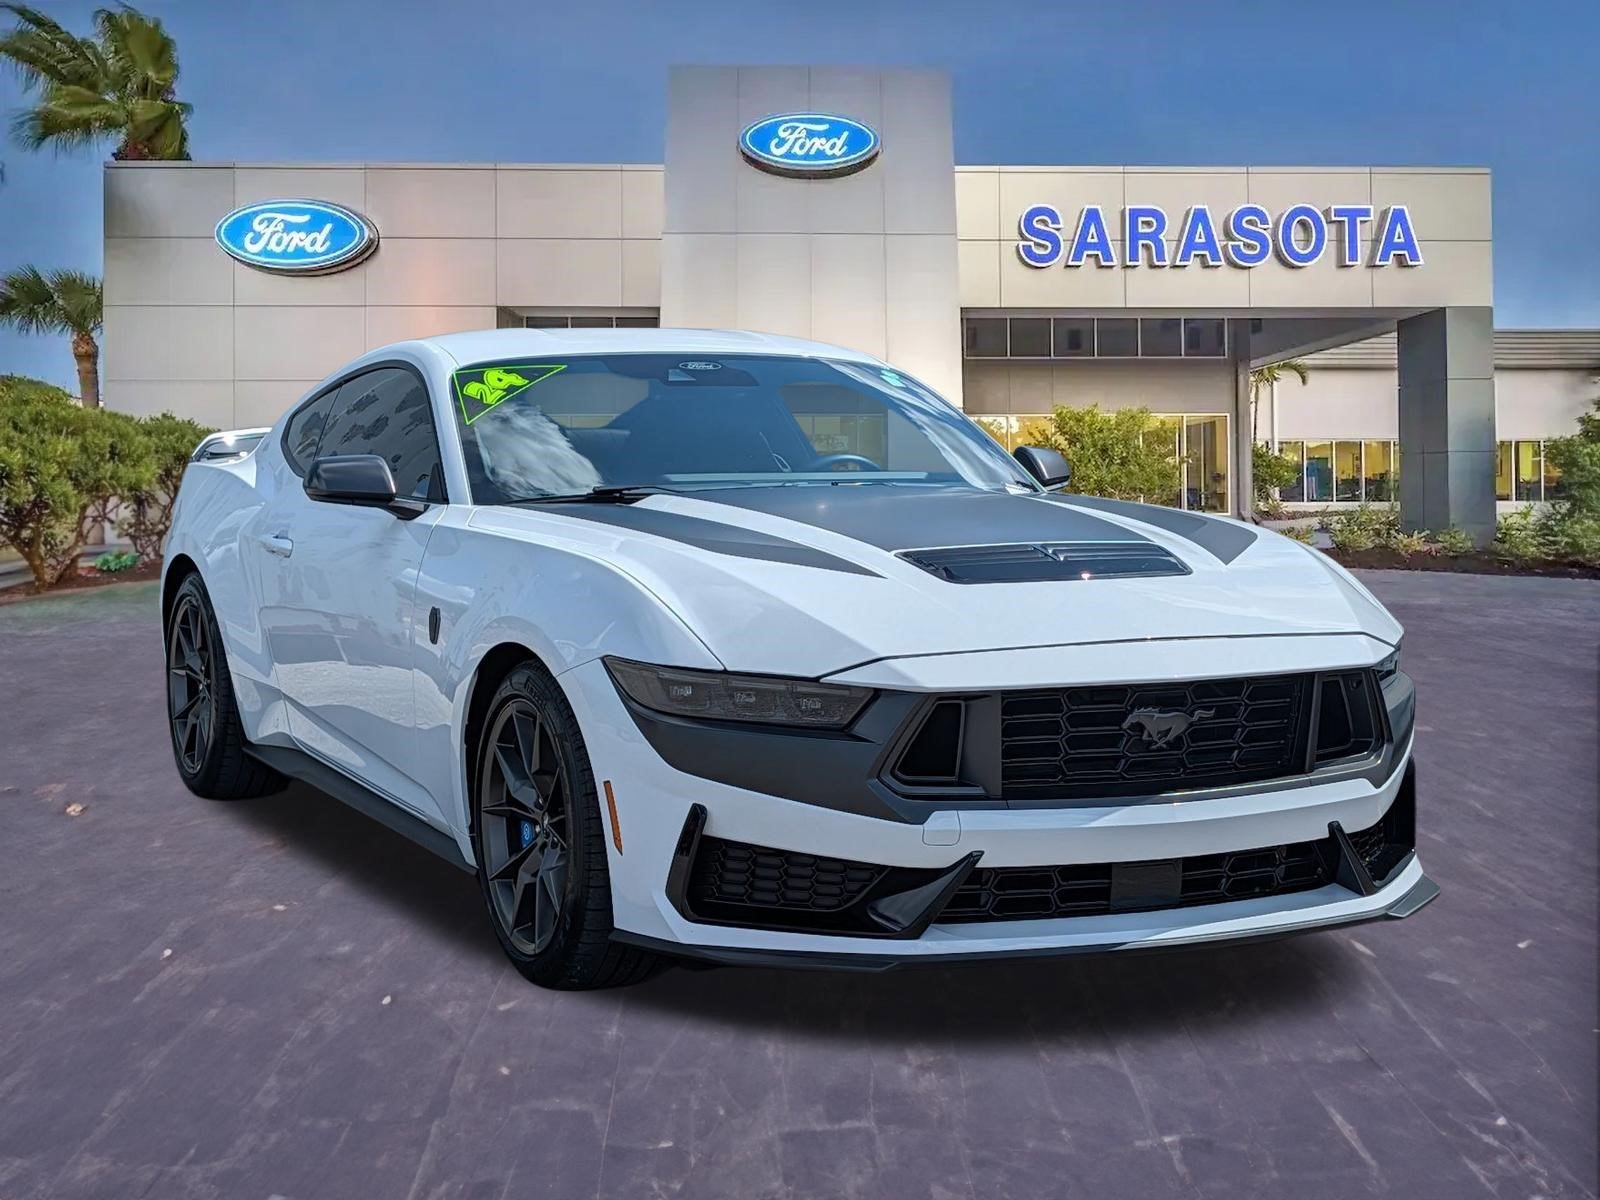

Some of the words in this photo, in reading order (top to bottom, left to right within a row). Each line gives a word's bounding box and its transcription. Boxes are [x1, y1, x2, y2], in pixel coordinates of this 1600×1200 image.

[769, 122, 849, 157] Ford
[244, 212, 333, 253] Ford
[1018, 203, 1426, 268] SARASOTA
